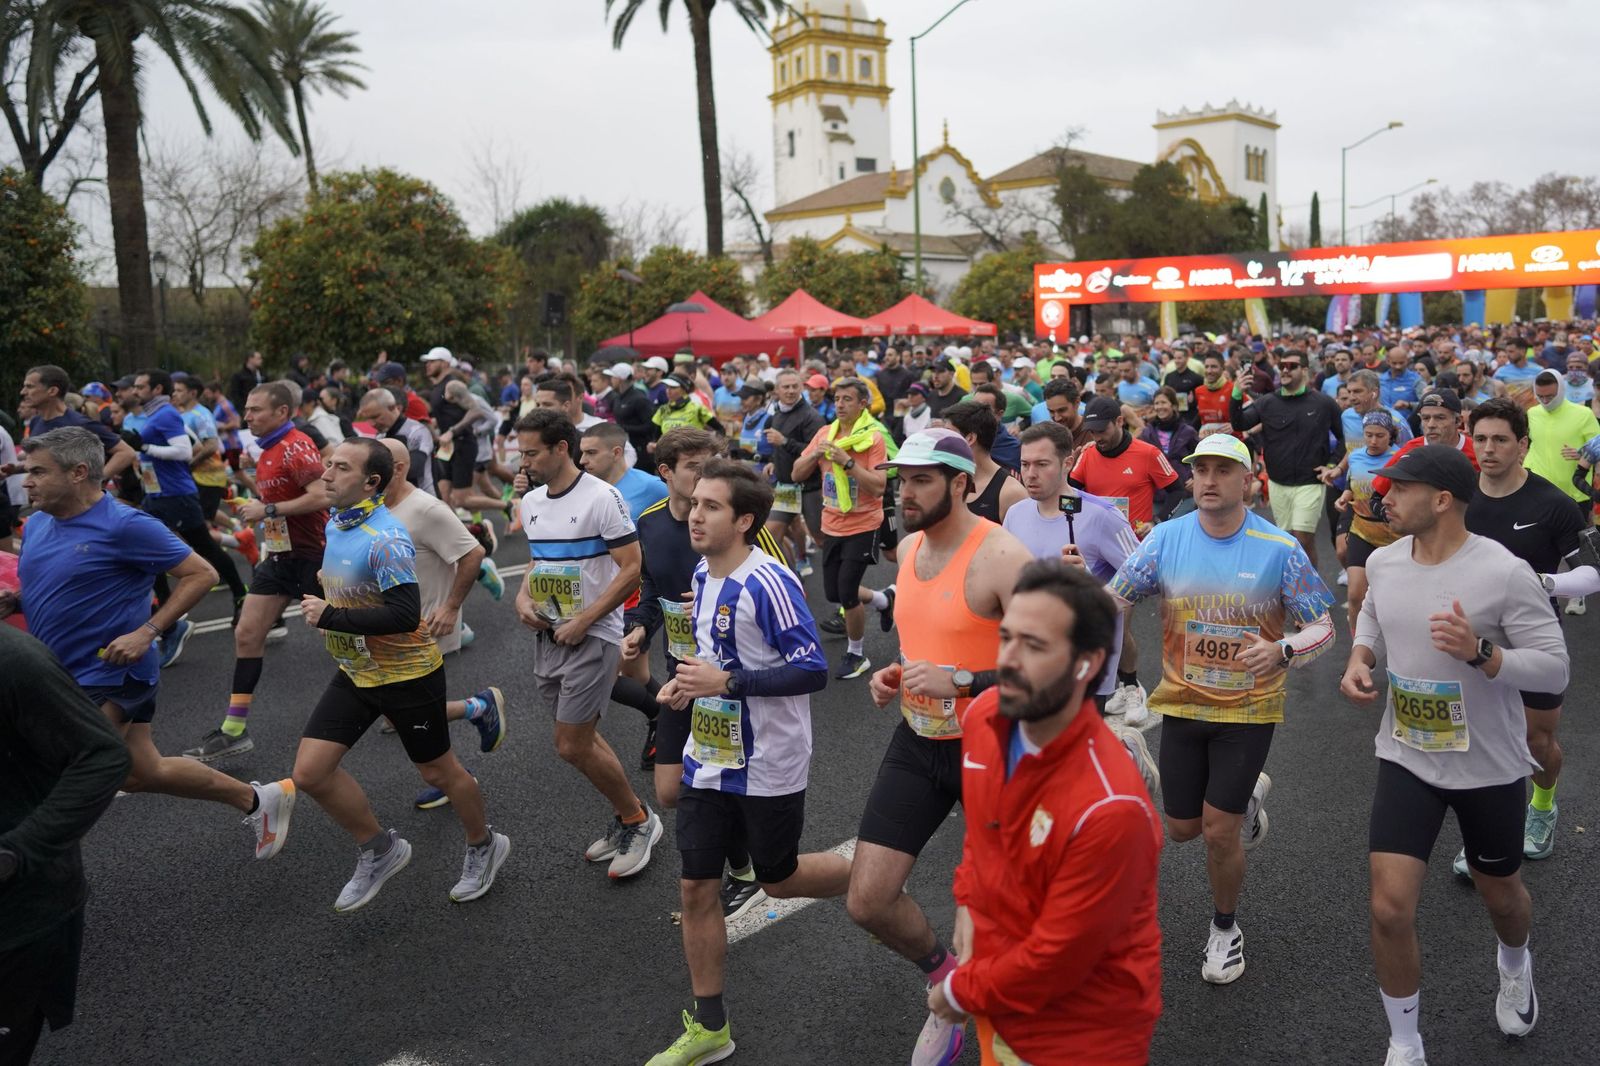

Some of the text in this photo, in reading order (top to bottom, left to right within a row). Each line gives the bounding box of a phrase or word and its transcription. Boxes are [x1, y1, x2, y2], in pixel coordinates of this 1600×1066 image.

[533, 578, 571, 595] 10788
[1183, 592, 1246, 609] MEDIO
[1195, 638, 1242, 662] 4987
[1393, 690, 1450, 721] 12658
[692, 709, 731, 738] 12935
